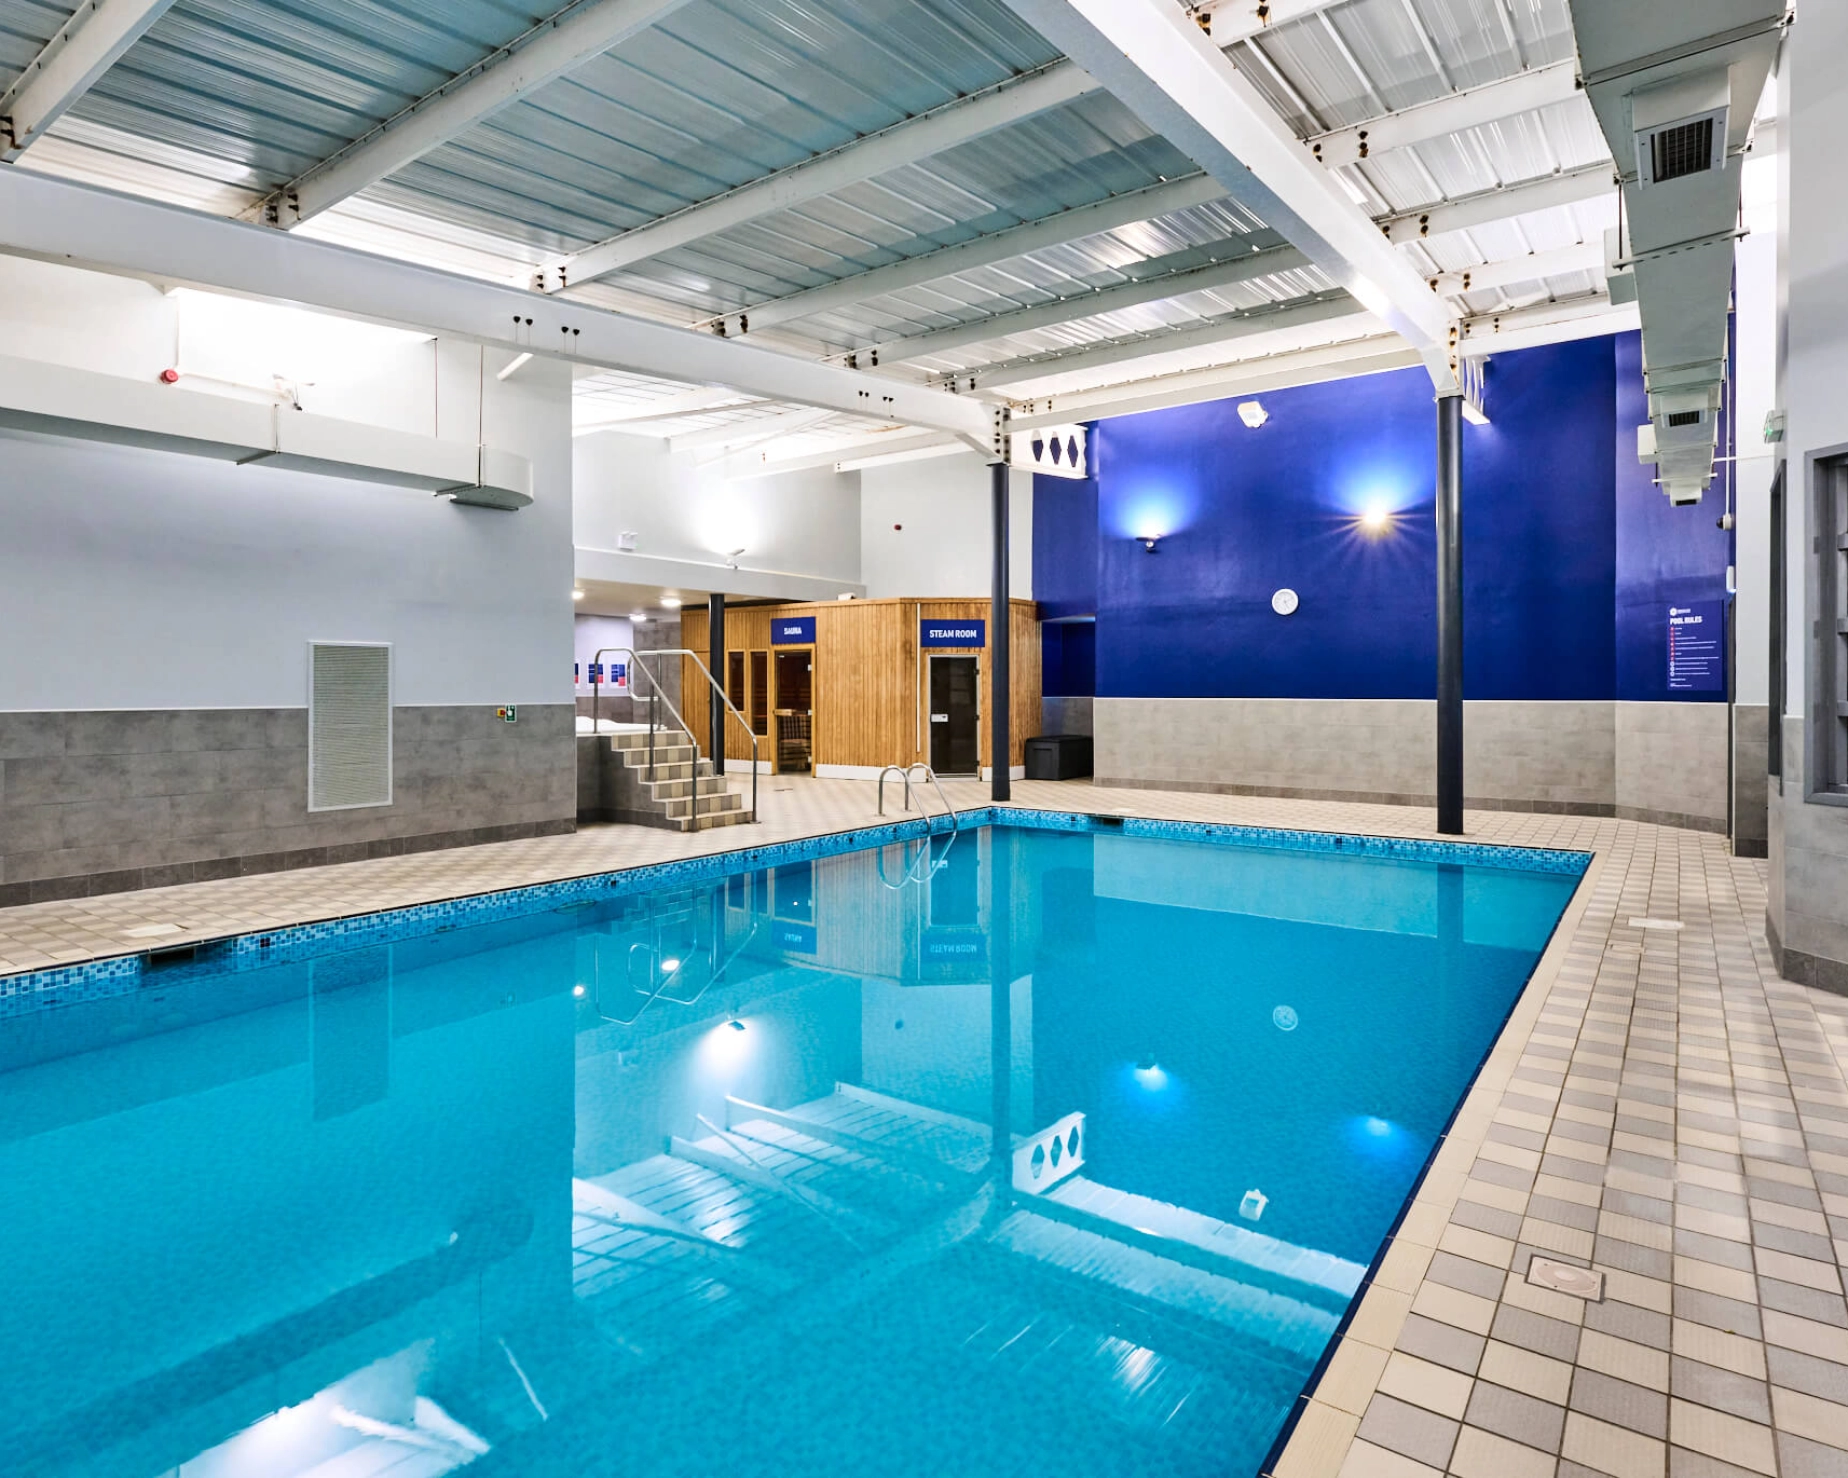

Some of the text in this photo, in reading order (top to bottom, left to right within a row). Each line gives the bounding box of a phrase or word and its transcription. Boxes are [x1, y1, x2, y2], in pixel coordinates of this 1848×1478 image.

[783, 626, 803, 635] SAUNA
[929, 629, 977, 639] STEAM ROOM
